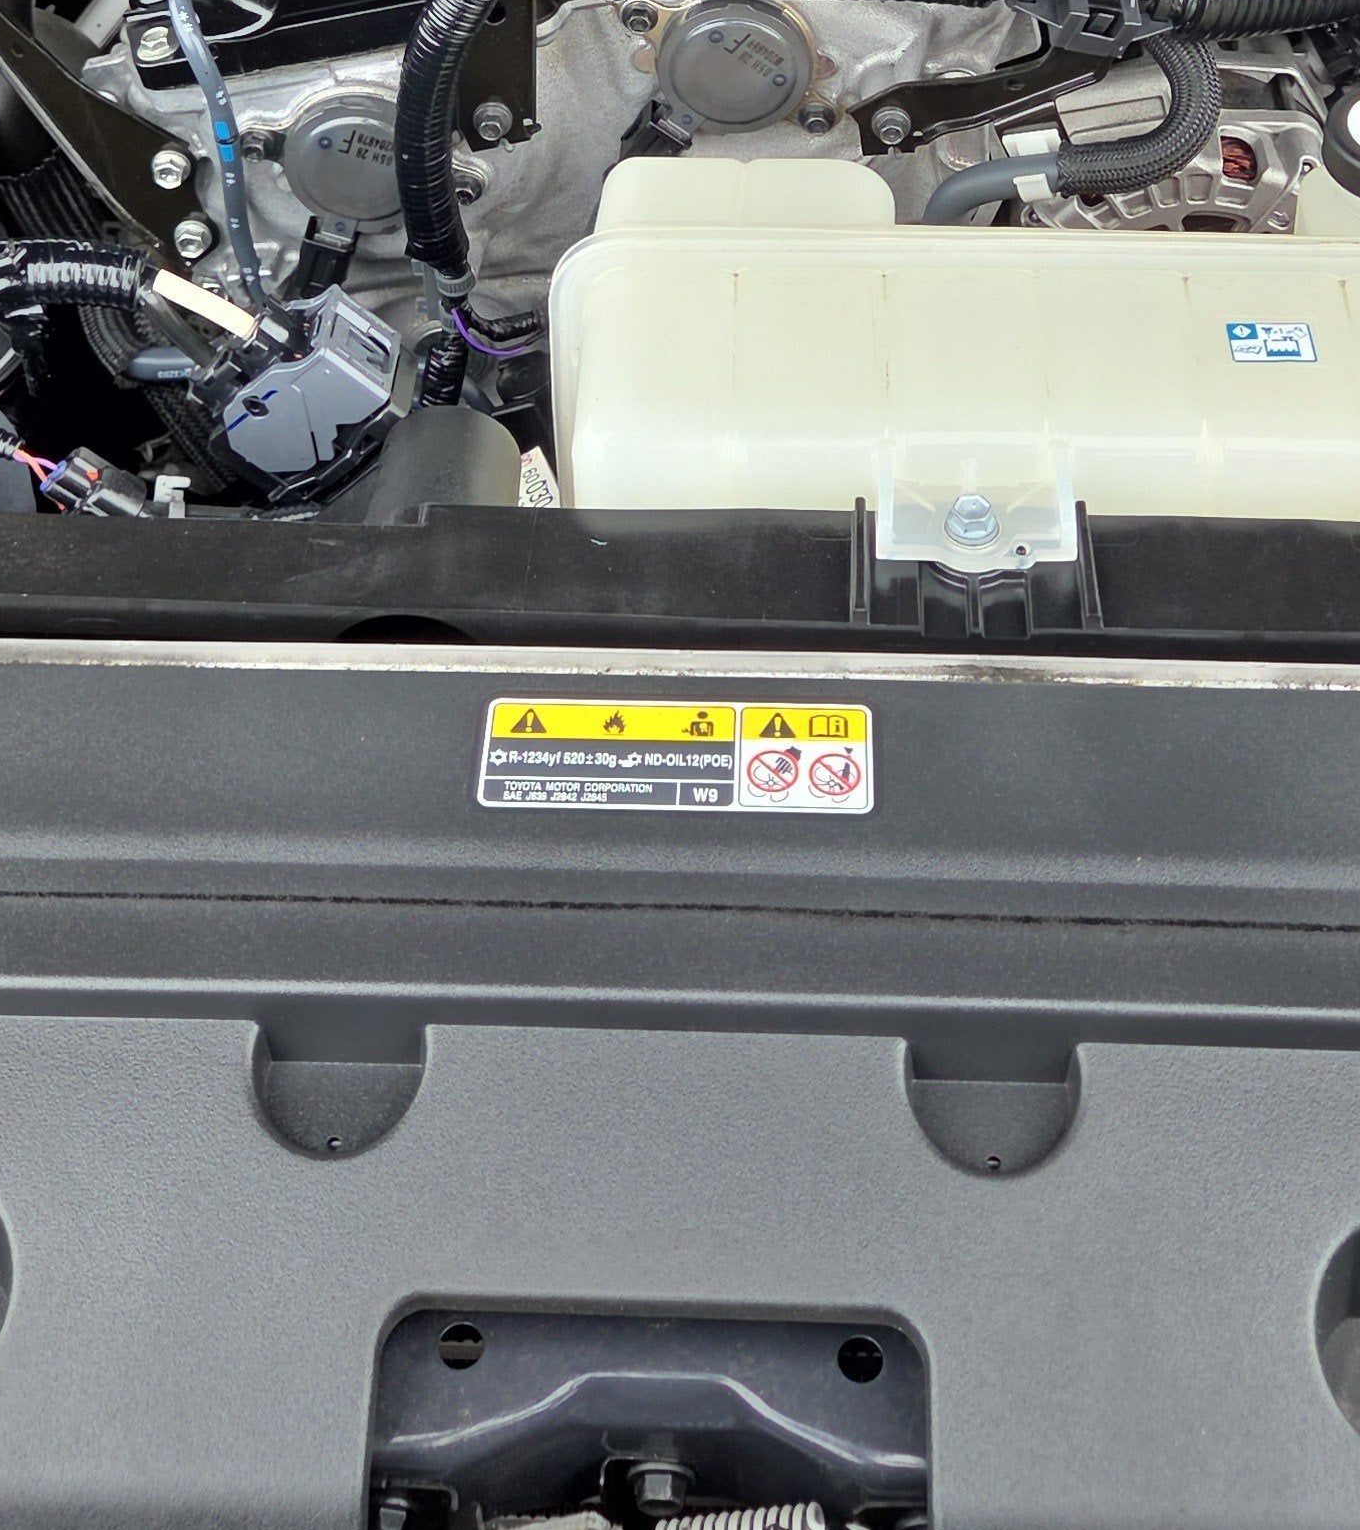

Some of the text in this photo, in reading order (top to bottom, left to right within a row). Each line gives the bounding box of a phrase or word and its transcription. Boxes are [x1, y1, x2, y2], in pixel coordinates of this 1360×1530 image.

[724, 33, 751, 54] F
[338, 130, 356, 154] F
[509, 751, 561, 767] R-1234yf
[645, 753, 733, 769] ND-OIL12(POE)
[503, 790, 522, 801] SAE
[504, 781, 653, 793] TOYOTA MOTOR CORPORATION
[693, 787, 719, 803] W9
